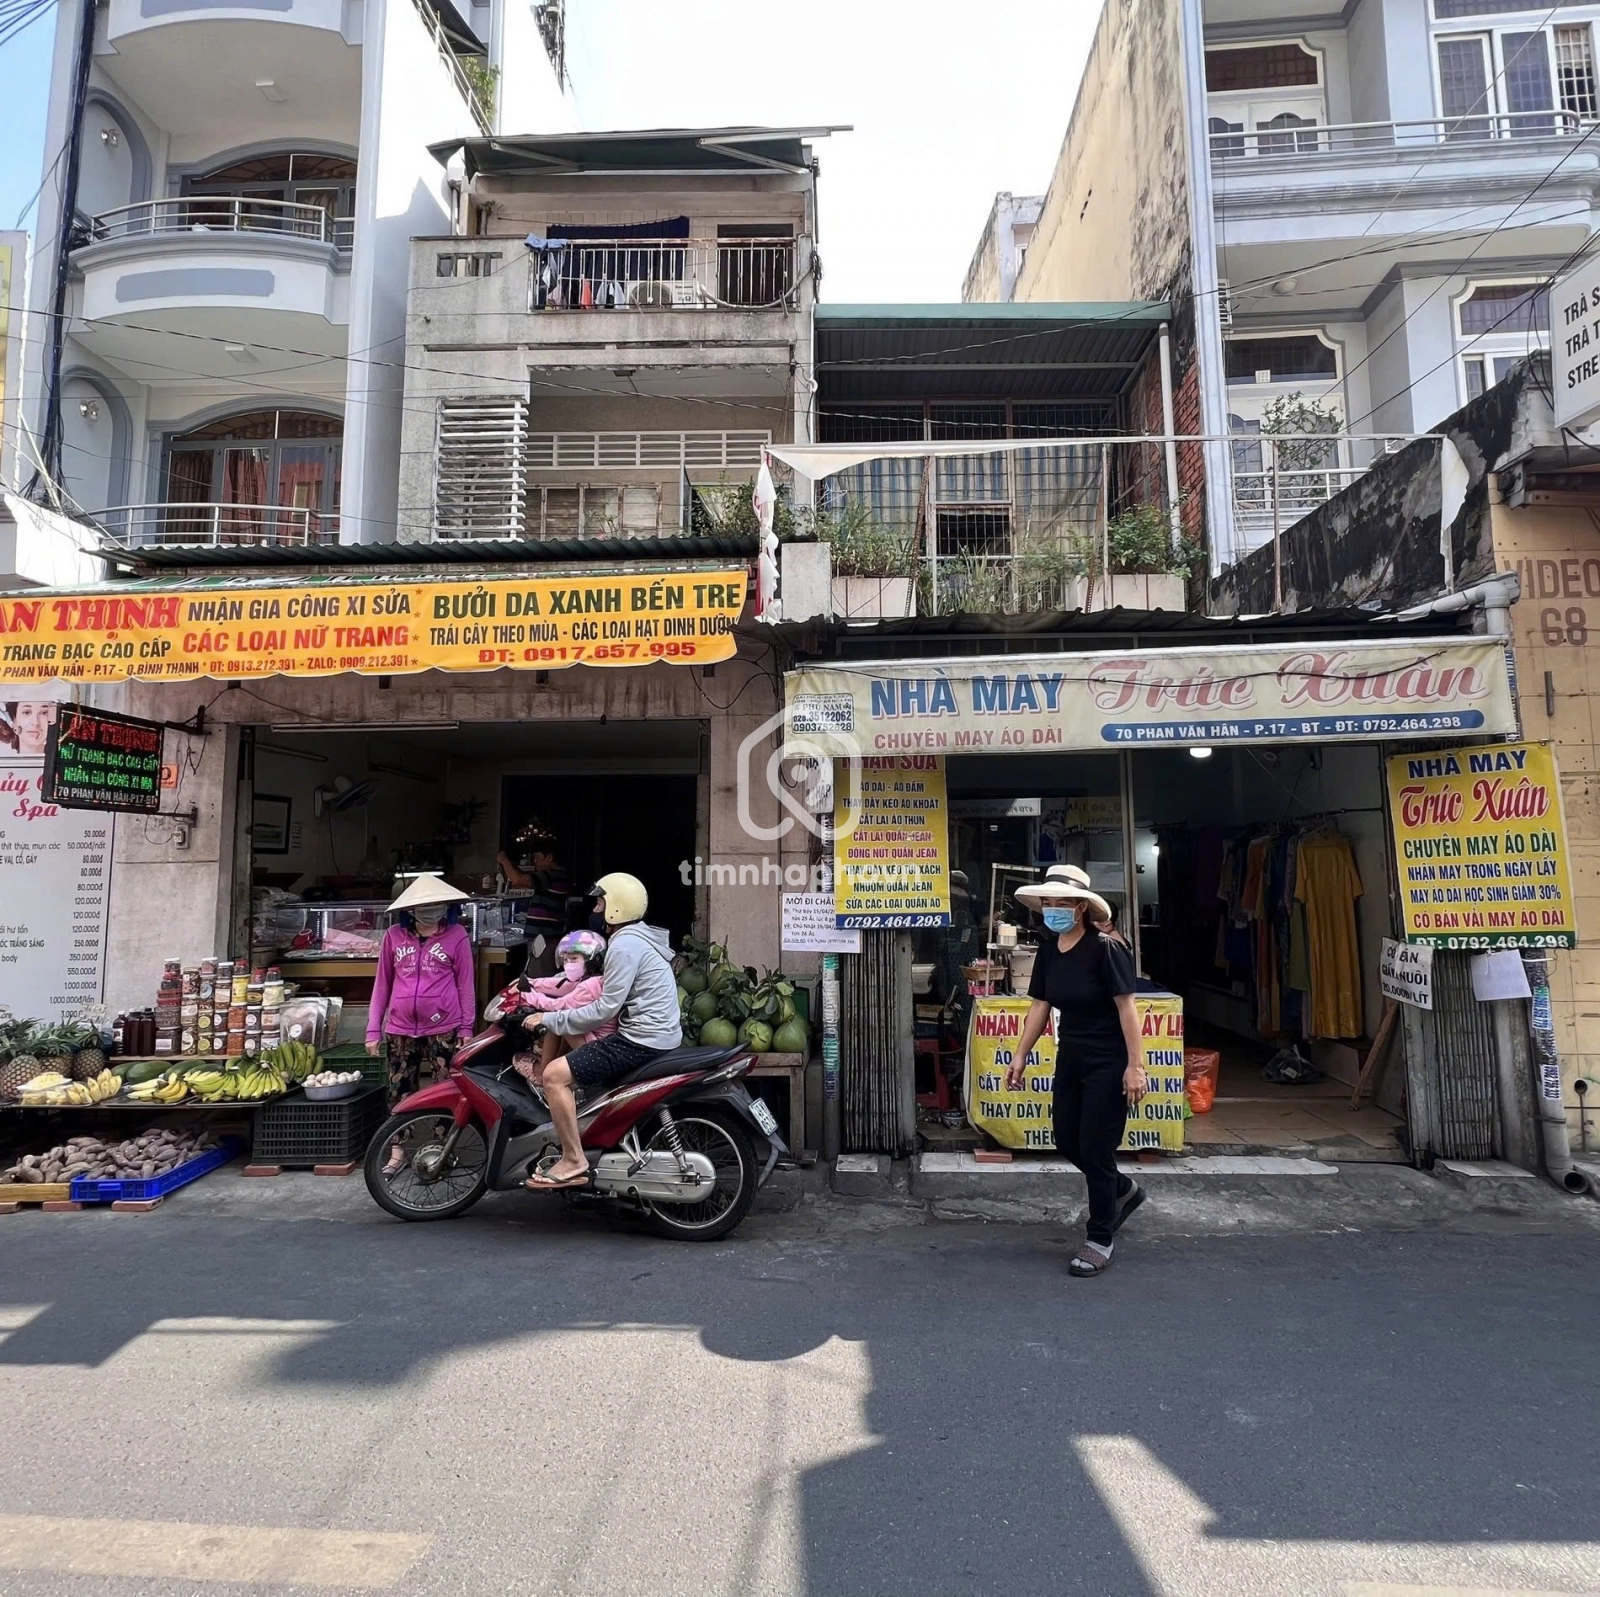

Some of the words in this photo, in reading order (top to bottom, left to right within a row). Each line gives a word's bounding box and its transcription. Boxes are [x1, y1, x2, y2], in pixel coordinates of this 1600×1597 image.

[187, 596, 243, 625] NHẬN
[248, 599, 281, 620] GIA
[286, 593, 341, 618] CÔNG
[345, 595, 366, 616] XI
[371, 588, 411, 615] SỬA
[433, 585, 497, 619] BƯỞI
[505, 591, 540, 617] DA
[548, 587, 622, 615] XANH
[630, 578, 684, 612] BẾN
[692, 583, 741, 609] TRE
[52, 596, 183, 641] THỊNH
[1540, 606, 1588, 647] 68
[182, 627, 230, 654] CÁC
[236, 629, 288, 655] LOẠI
[293, 624, 329, 650] NỮ
[333, 625, 409, 649] TRANG
[429, 622, 459, 646] TRÁI
[462, 622, 489, 645] CÂY
[492, 624, 525, 644] THEO
[529, 619, 559, 642] MÙA
[571, 617, 598, 641] CÁC
[602, 620, 631, 643] LOẠI
[634, 618, 660, 642] HẠT
[663, 617, 695, 638] DINH
[2, 643, 57, 661] TRANG
[61, 642, 95, 663] BẠC
[99, 642, 135, 659] CAO
[139, 634, 172, 658] CẤP
[477, 648, 515, 663] ĐT:
[523, 642, 697, 662] 0917.657.995
[2, 666, 36, 678] PHAN
[37, 662, 60, 677] VĂN
[93, 663, 116, 676] P.17
[126, 661, 163, 677] Q.BÌNH
[165, 661, 199, 677] THẠNH
[209, 661, 225, 673] ĐT:
[307, 656, 337, 670] ZALO:
[339, 655, 409, 670] 0909.212.391
[869, 667, 960, 719] NHÀ
[970, 672, 1067, 716] MAY
[1087, 658, 1258, 715] Trúc
[1276, 650, 1492, 711] Xuân
[873, 728, 948, 750] CHUYÊN
[954, 730, 995, 747] MAY
[1000, 725, 1026, 746] ÁO
[1031, 724, 1063, 745] DÀI
[1115, 727, 1133, 740] 70
[1136, 726, 1175, 740] PHAN
[1178, 724, 1206, 738] VĂN
[1210, 722, 1240, 737] HÂN
[1254, 723, 1287, 736] P.17
[1301, 721, 1321, 734] BT
[1334, 720, 1359, 732] ĐT:
[1362, 716, 1462, 732] 0792.464.298
[77, 747, 106, 765] TRANG
[1407, 752, 1462, 779] NHÀ
[1468, 749, 1528, 774] MAY
[58, 786, 70, 798] 70
[71, 787, 95, 800] PHAN
[1399, 783, 1464, 828] Trúc
[1471, 776, 1550, 823] Xuân
[12, 797, 60, 822] Spa
[904, 815, 926, 826] THUN
[83, 829, 106, 839] 50.000đ
[1403, 833, 1462, 860] CHUYÊN
[1466, 835, 1499, 856] MAY
[1505, 829, 1526, 855] ÁO
[1530, 827, 1558, 853] DÀI
[915, 848, 938, 859] JEAN
[1407, 862, 1436, 884] NHẬN
[1439, 864, 1462, 880] MAY
[1464, 862, 1501, 879] TRONG
[1504, 858, 1534, 877] NGÀY
[1536, 855, 1557, 876] LẤY
[911, 881, 933, 893] JEAN
[1410, 888, 1430, 904] MAY
[1432, 884, 1444, 903] ÁO
[1446, 884, 1462, 903] DÀI
[1465, 885, 1484, 906] HỌC
[1487, 885, 1510, 902] SINH
[1512, 881, 1537, 901] GIẢM
[1539, 883, 1562, 900] 30%
[74, 896, 102, 906] 120.000đ
[72, 910, 101, 920] 120.000đ
[843, 914, 943, 929] 0792.464.298
[1413, 908, 1431, 929] CÓ
[1434, 908, 1460, 929] BÁN
[1463, 906, 1484, 928] VẢI
[1488, 910, 1516, 928] MAY
[1520, 907, 1538, 927] ÁO
[1541, 905, 1565, 926] DÀI
[72, 924, 100, 934] 120.000đ
[1447, 934, 1569, 951] 0792.464.298
[1, 953, 18, 964] body
[67, 966, 97, 976] 550.000đ
[975, 1008, 1020, 1044] NHẬN
[1146, 1050, 1183, 1067] THUN
[978, 1071, 1002, 1093] CẮT
[979, 1101, 1013, 1119] THAY
[1016, 1099, 1043, 1119] DÂY
[1127, 1130, 1161, 1148] SINH
